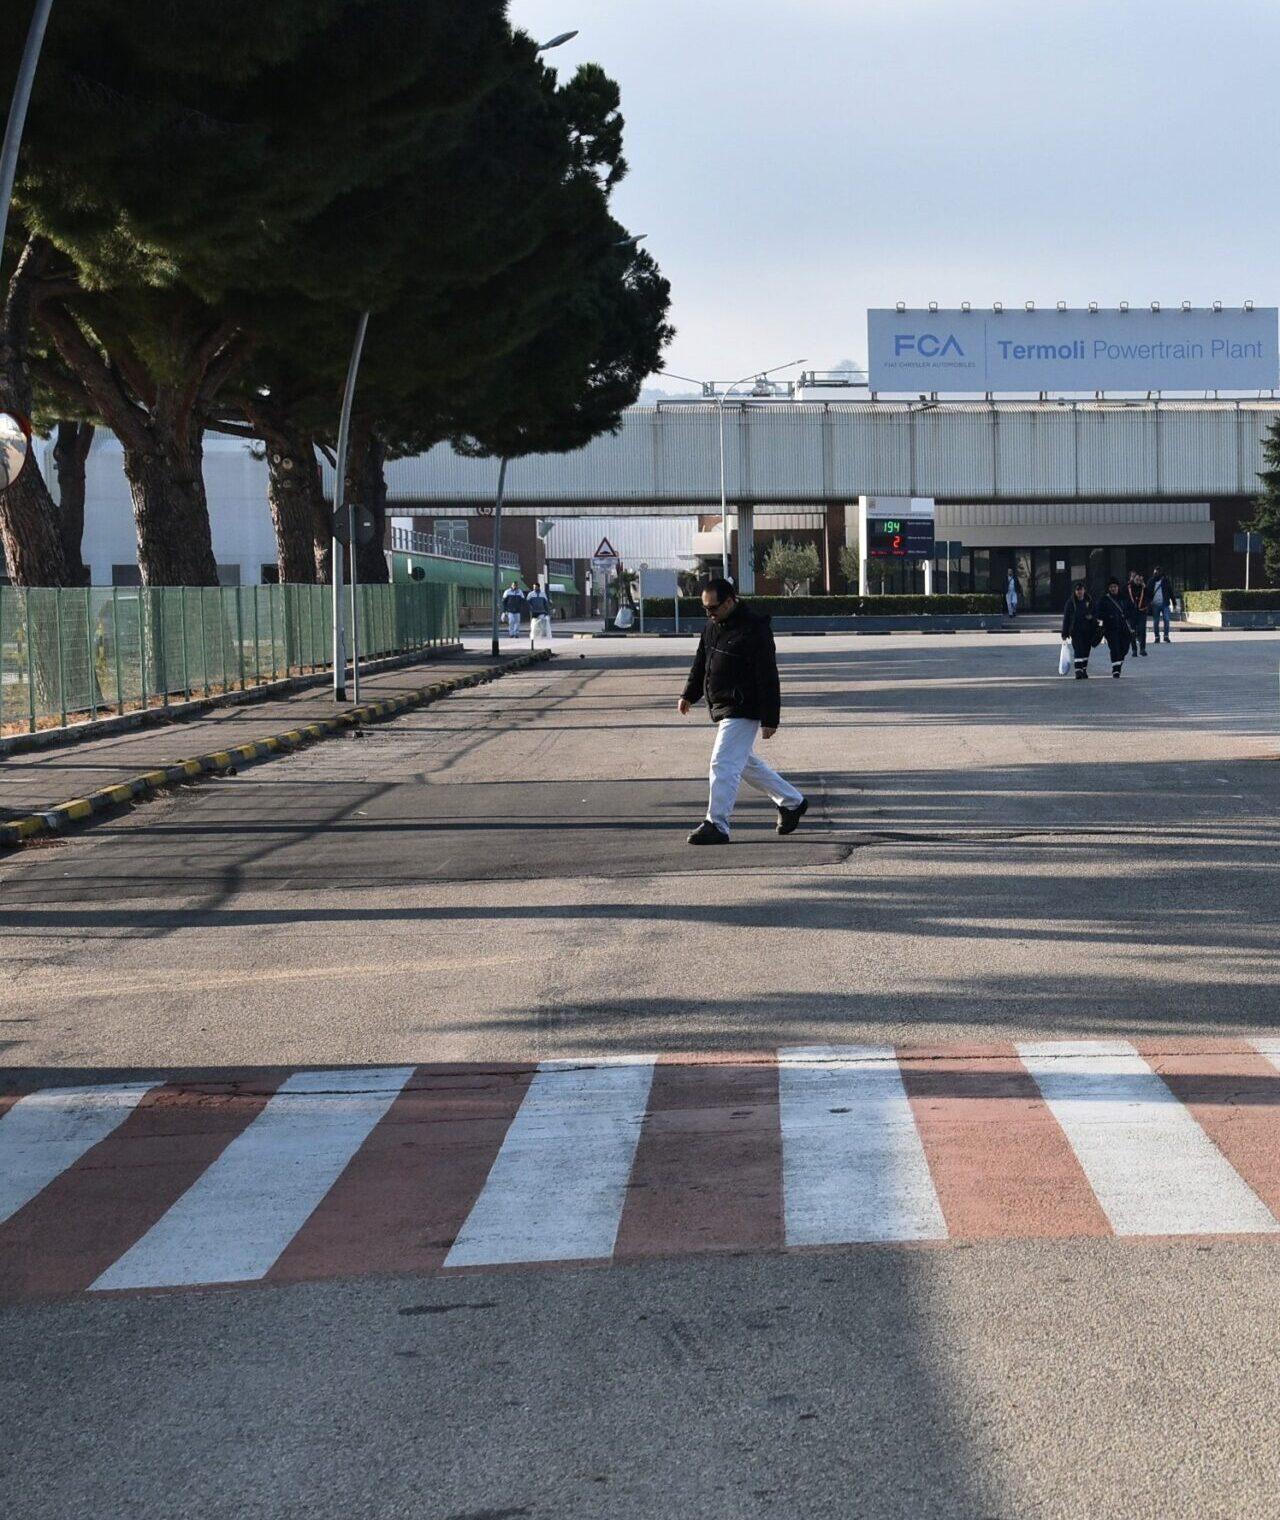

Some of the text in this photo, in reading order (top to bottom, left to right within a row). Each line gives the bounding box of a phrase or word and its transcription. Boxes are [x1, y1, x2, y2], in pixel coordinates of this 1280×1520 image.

[894, 334, 964, 356] FCA
[998, 338, 1263, 360] Termoli Powertrain Plant
[884, 521, 900, 532] 194
[893, 535, 900, 548] 2
